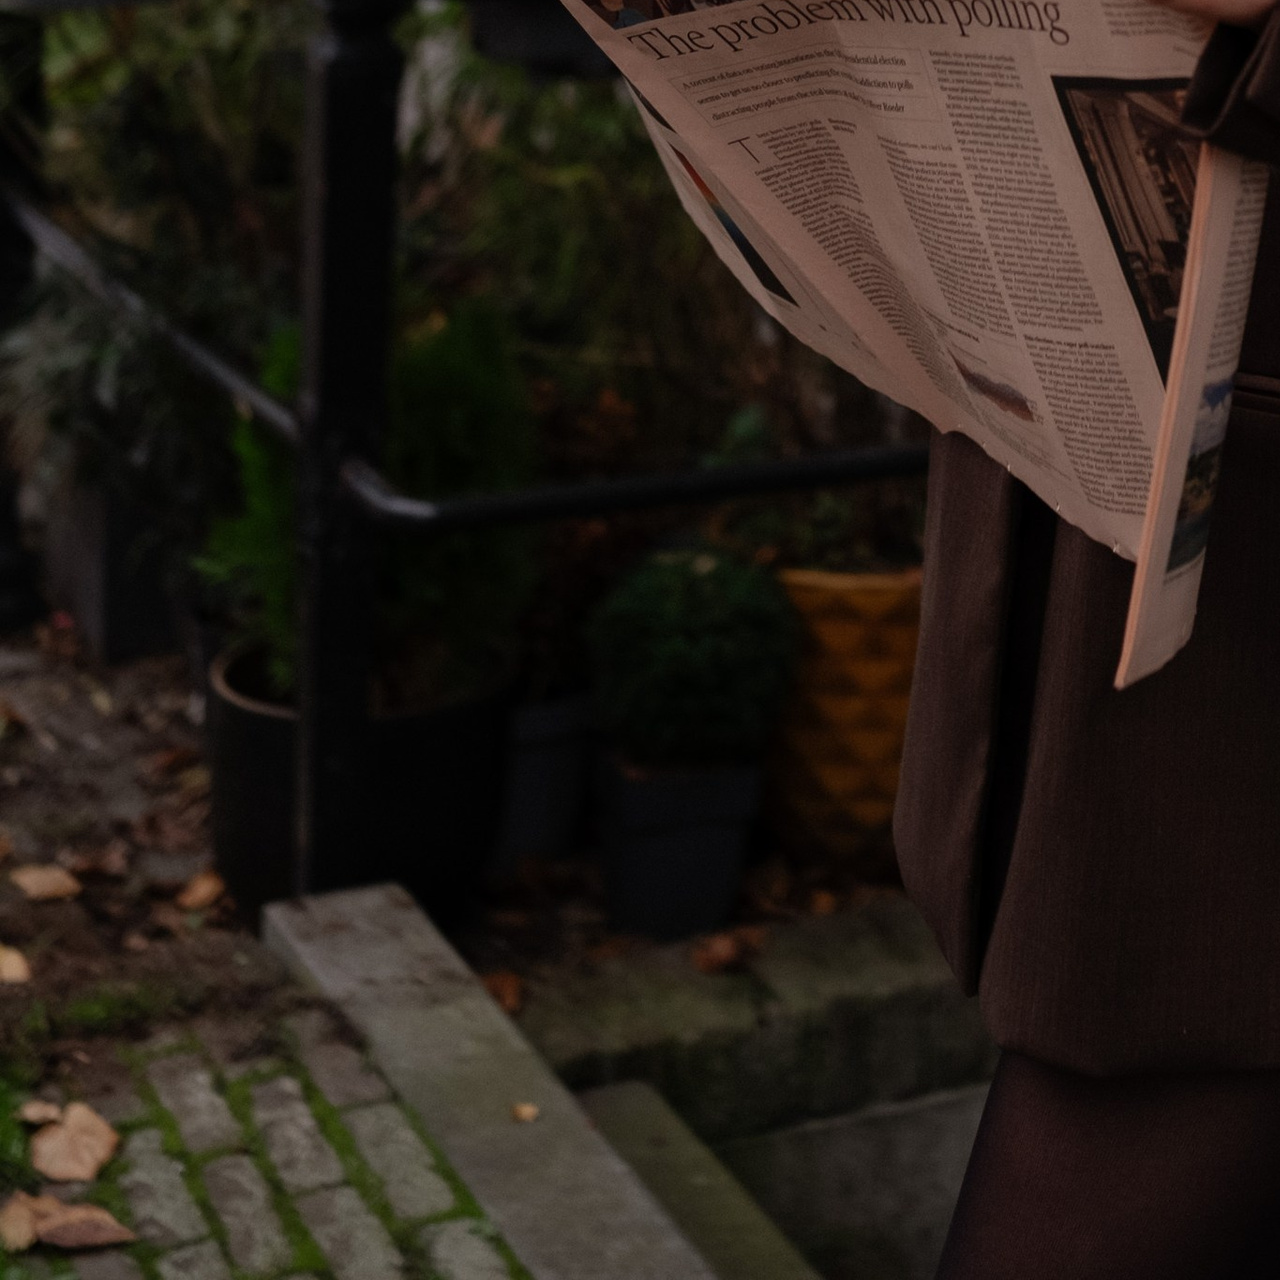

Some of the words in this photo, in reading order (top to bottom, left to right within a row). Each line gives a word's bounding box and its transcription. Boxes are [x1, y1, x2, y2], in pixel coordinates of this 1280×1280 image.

[627, 27, 714, 60] The
[682, 82, 691, 91] A
[689, 75, 716, 88] torrent
[717, 72, 727, 80] of
[878, 55, 907, 66] election
[896, 79, 914, 91] polls
[697, 94, 721, 105] seems
[720, 91, 730, 99] to
[729, 88, 741, 97] get
[762, 78, 784, 89] closer
[752, 99, 779, 111] people
